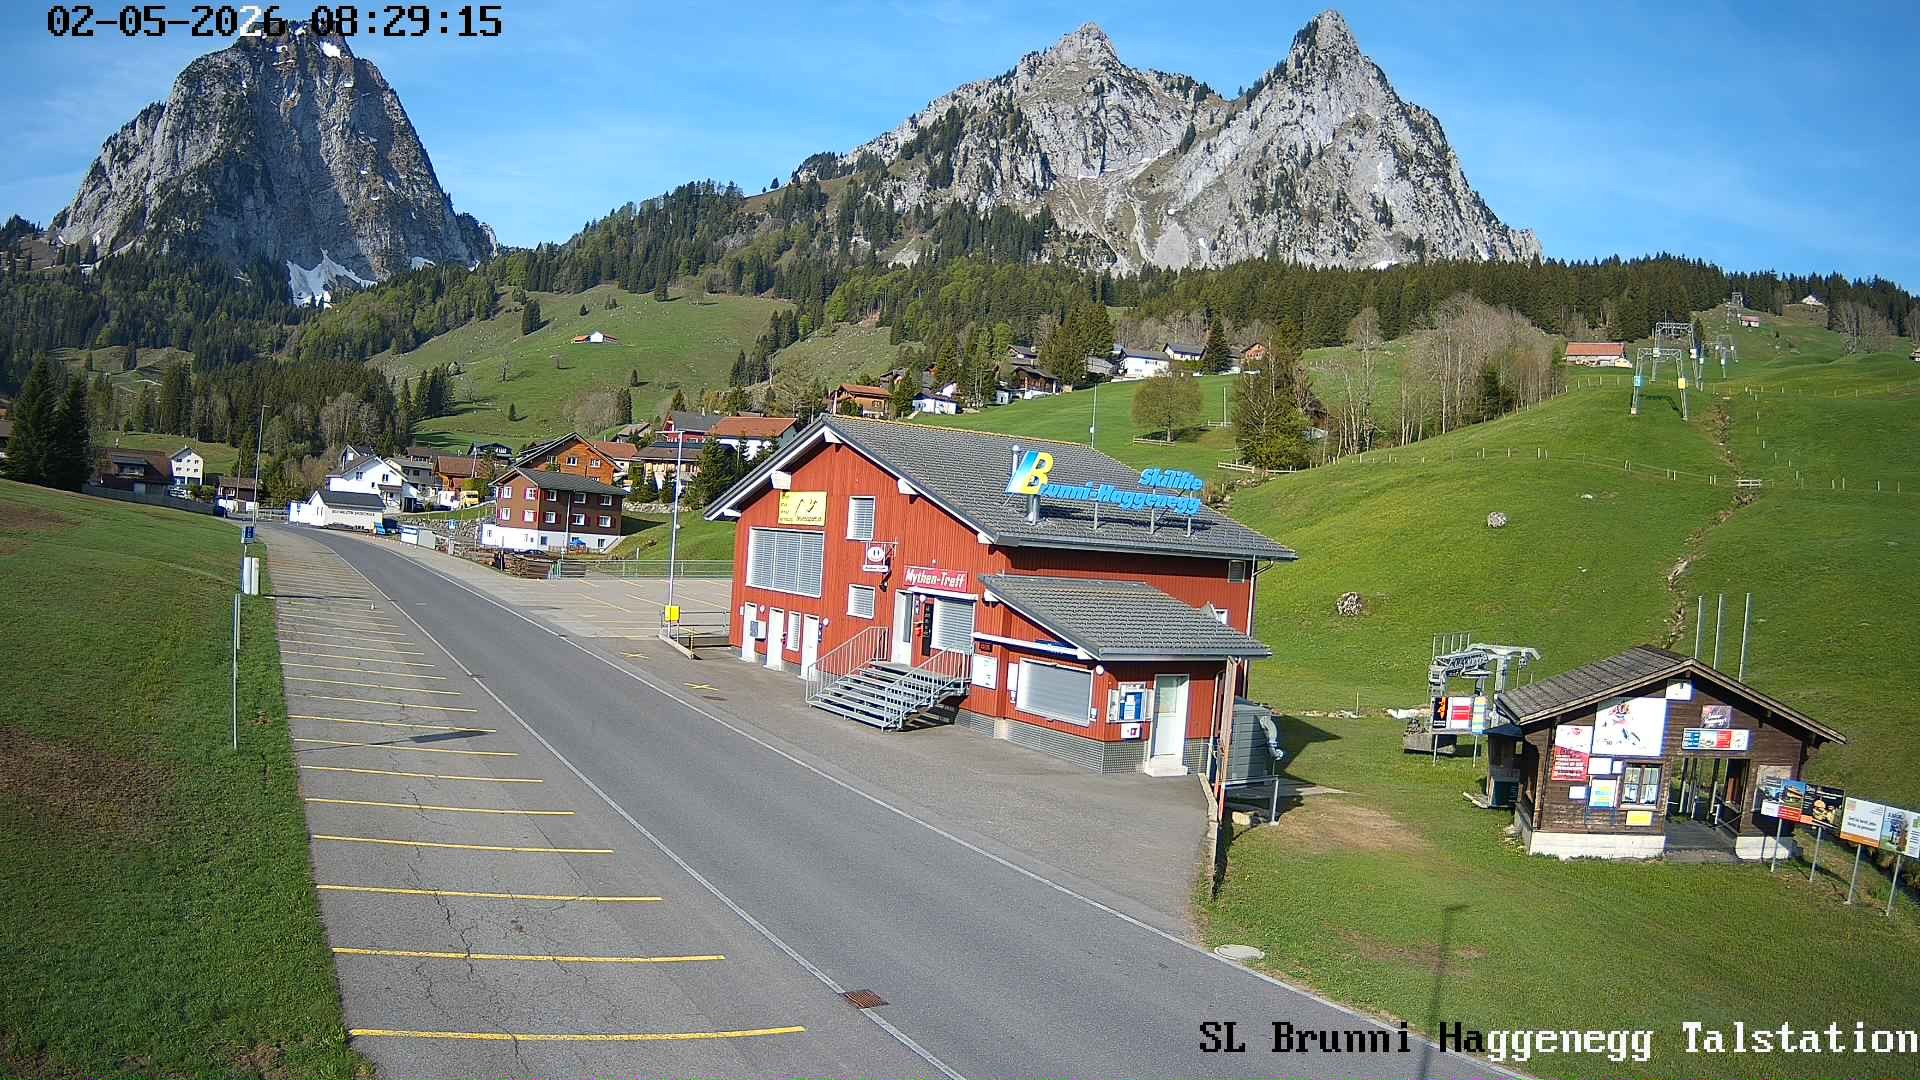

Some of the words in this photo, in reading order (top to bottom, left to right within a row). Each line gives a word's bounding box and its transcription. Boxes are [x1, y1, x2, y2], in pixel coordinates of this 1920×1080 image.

[1005, 451, 1202, 516] Brunni-Haggenegg
[1140, 468, 1204, 491] Skilifte
[905, 567, 964, 588] Mythen-Treff
